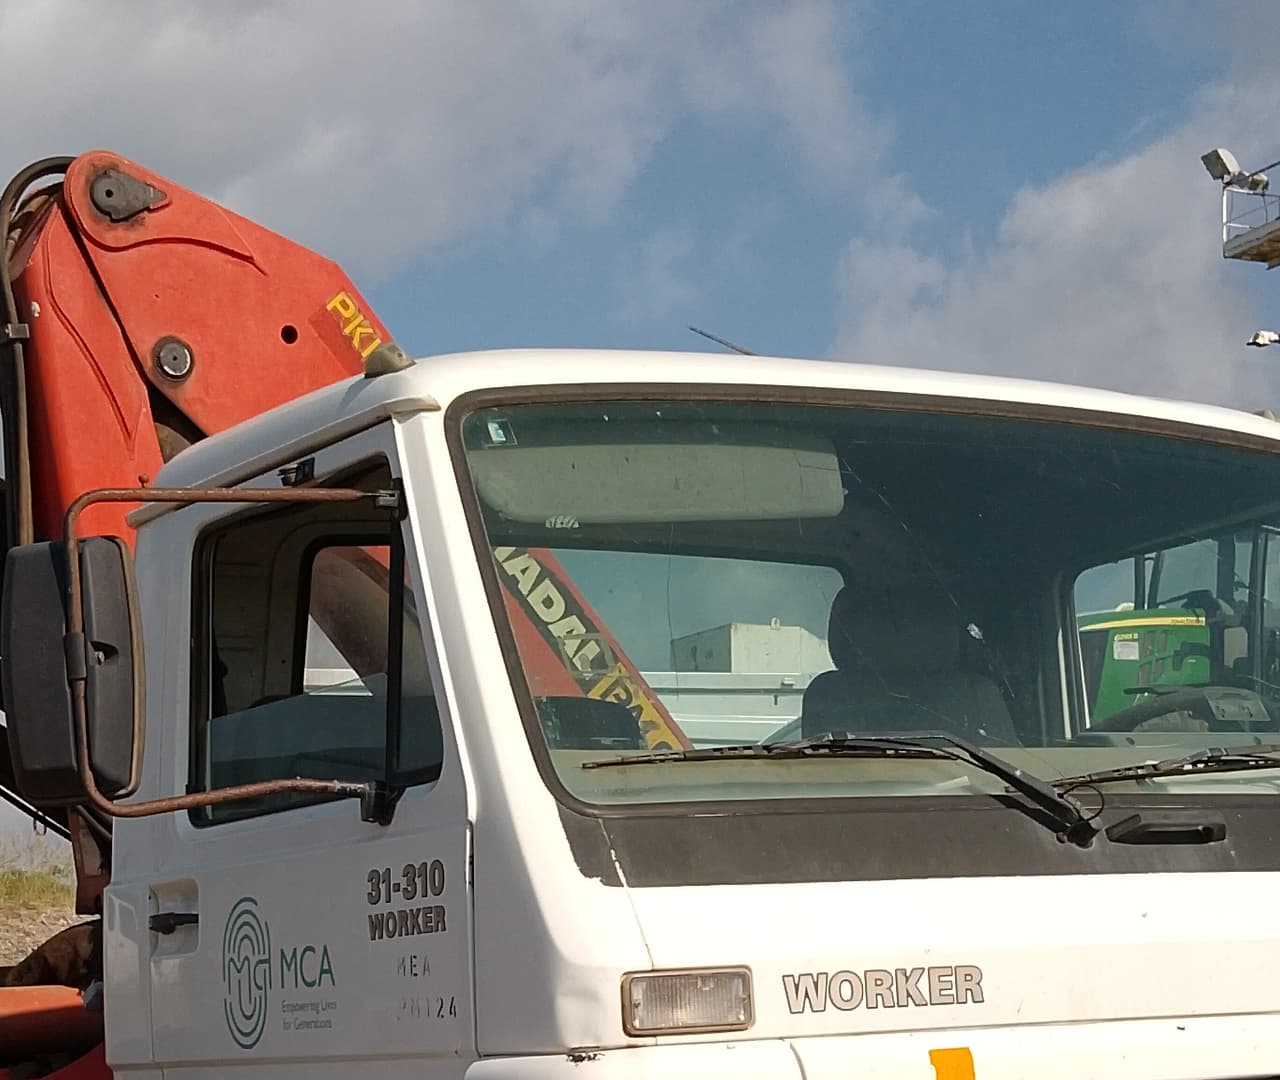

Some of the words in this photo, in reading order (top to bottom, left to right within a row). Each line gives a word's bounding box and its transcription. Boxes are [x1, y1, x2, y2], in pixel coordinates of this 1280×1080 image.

[367, 859, 445, 905] 31-310
[368, 905, 447, 941] WORKER
[280, 944, 336, 989] MCA
[782, 965, 985, 1014] WORKER
